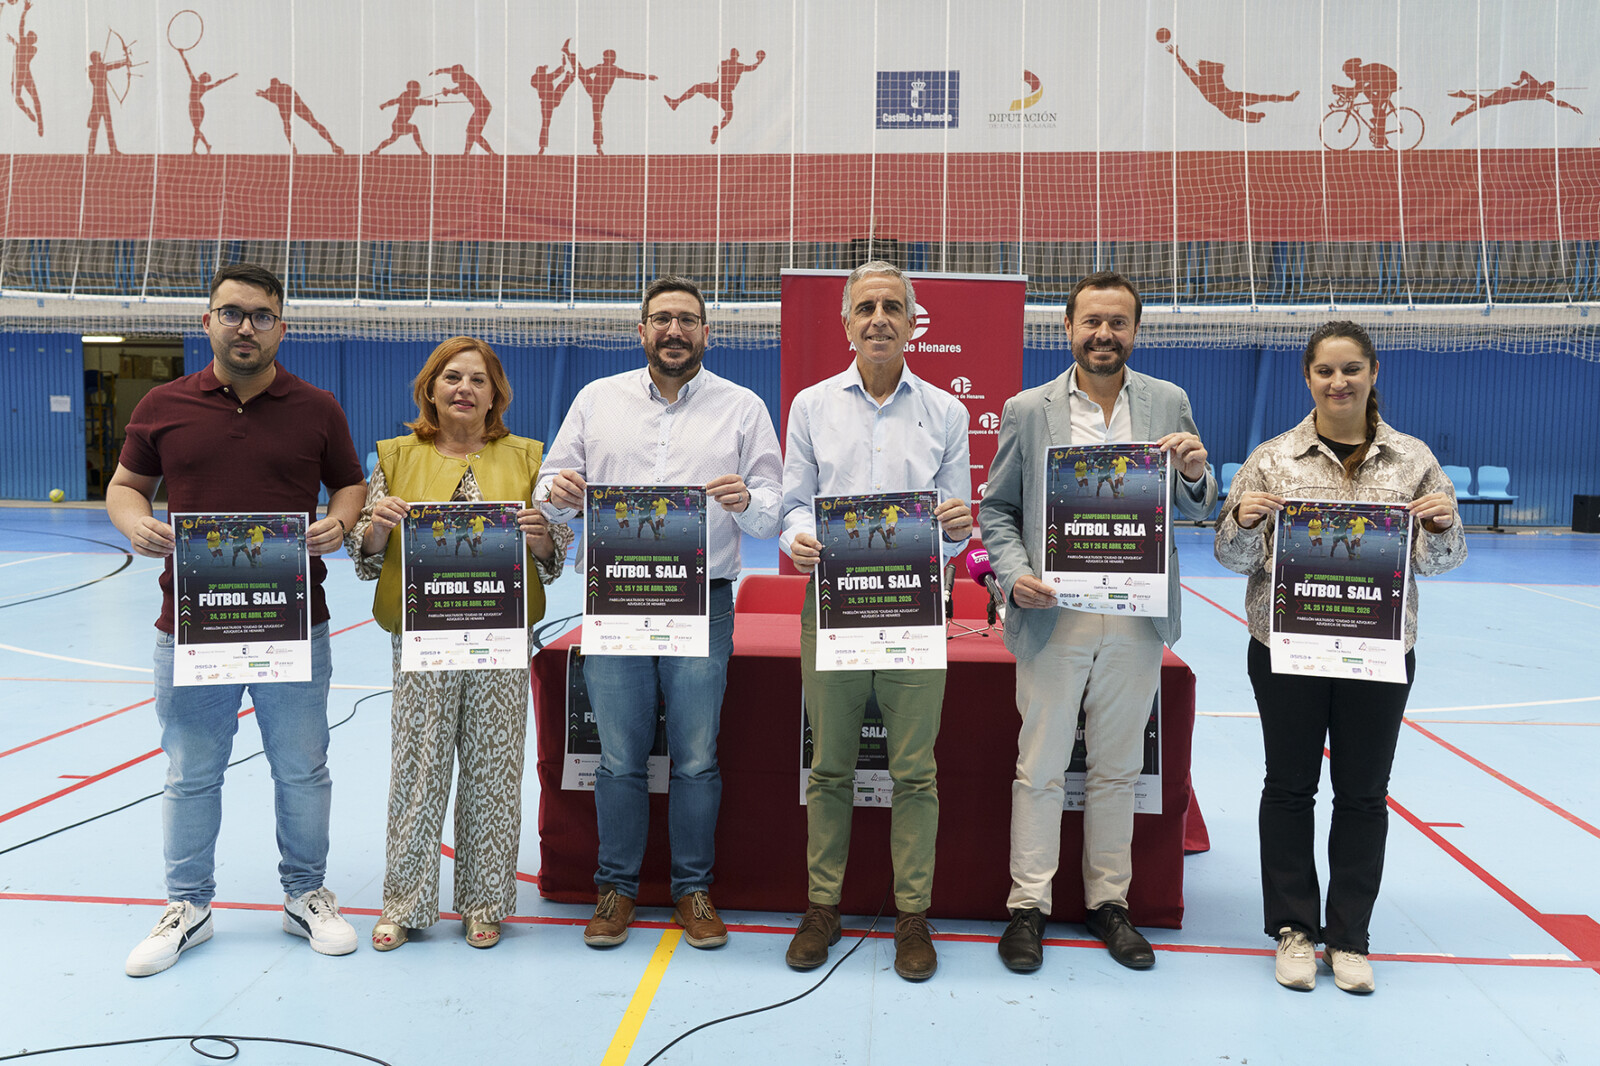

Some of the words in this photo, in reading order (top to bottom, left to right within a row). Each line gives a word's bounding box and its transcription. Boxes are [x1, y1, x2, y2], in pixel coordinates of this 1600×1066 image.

[883, 112, 922, 122] Castilla-La
[989, 111, 1056, 122] DIPUTACIÓN
[903, 342, 915, 352] de
[918, 342, 961, 353] Henares
[1065, 519, 1109, 536] FÚTBOL
[1114, 523, 1146, 536] SALA
[606, 561, 651, 578] FÚTBOL
[655, 565, 688, 578] SALA
[424, 578, 469, 595] FÚTBOL
[474, 580, 505, 594] SALA
[837, 572, 884, 590] FÚTBOL
[888, 574, 922, 588] SALA
[199, 589, 248, 606] FÚTBOL
[253, 591, 287, 605] SALA
[1294, 579, 1343, 598] FÚTBOL
[1347, 586, 1382, 601] SALA
[862, 726, 887, 738] SALA
